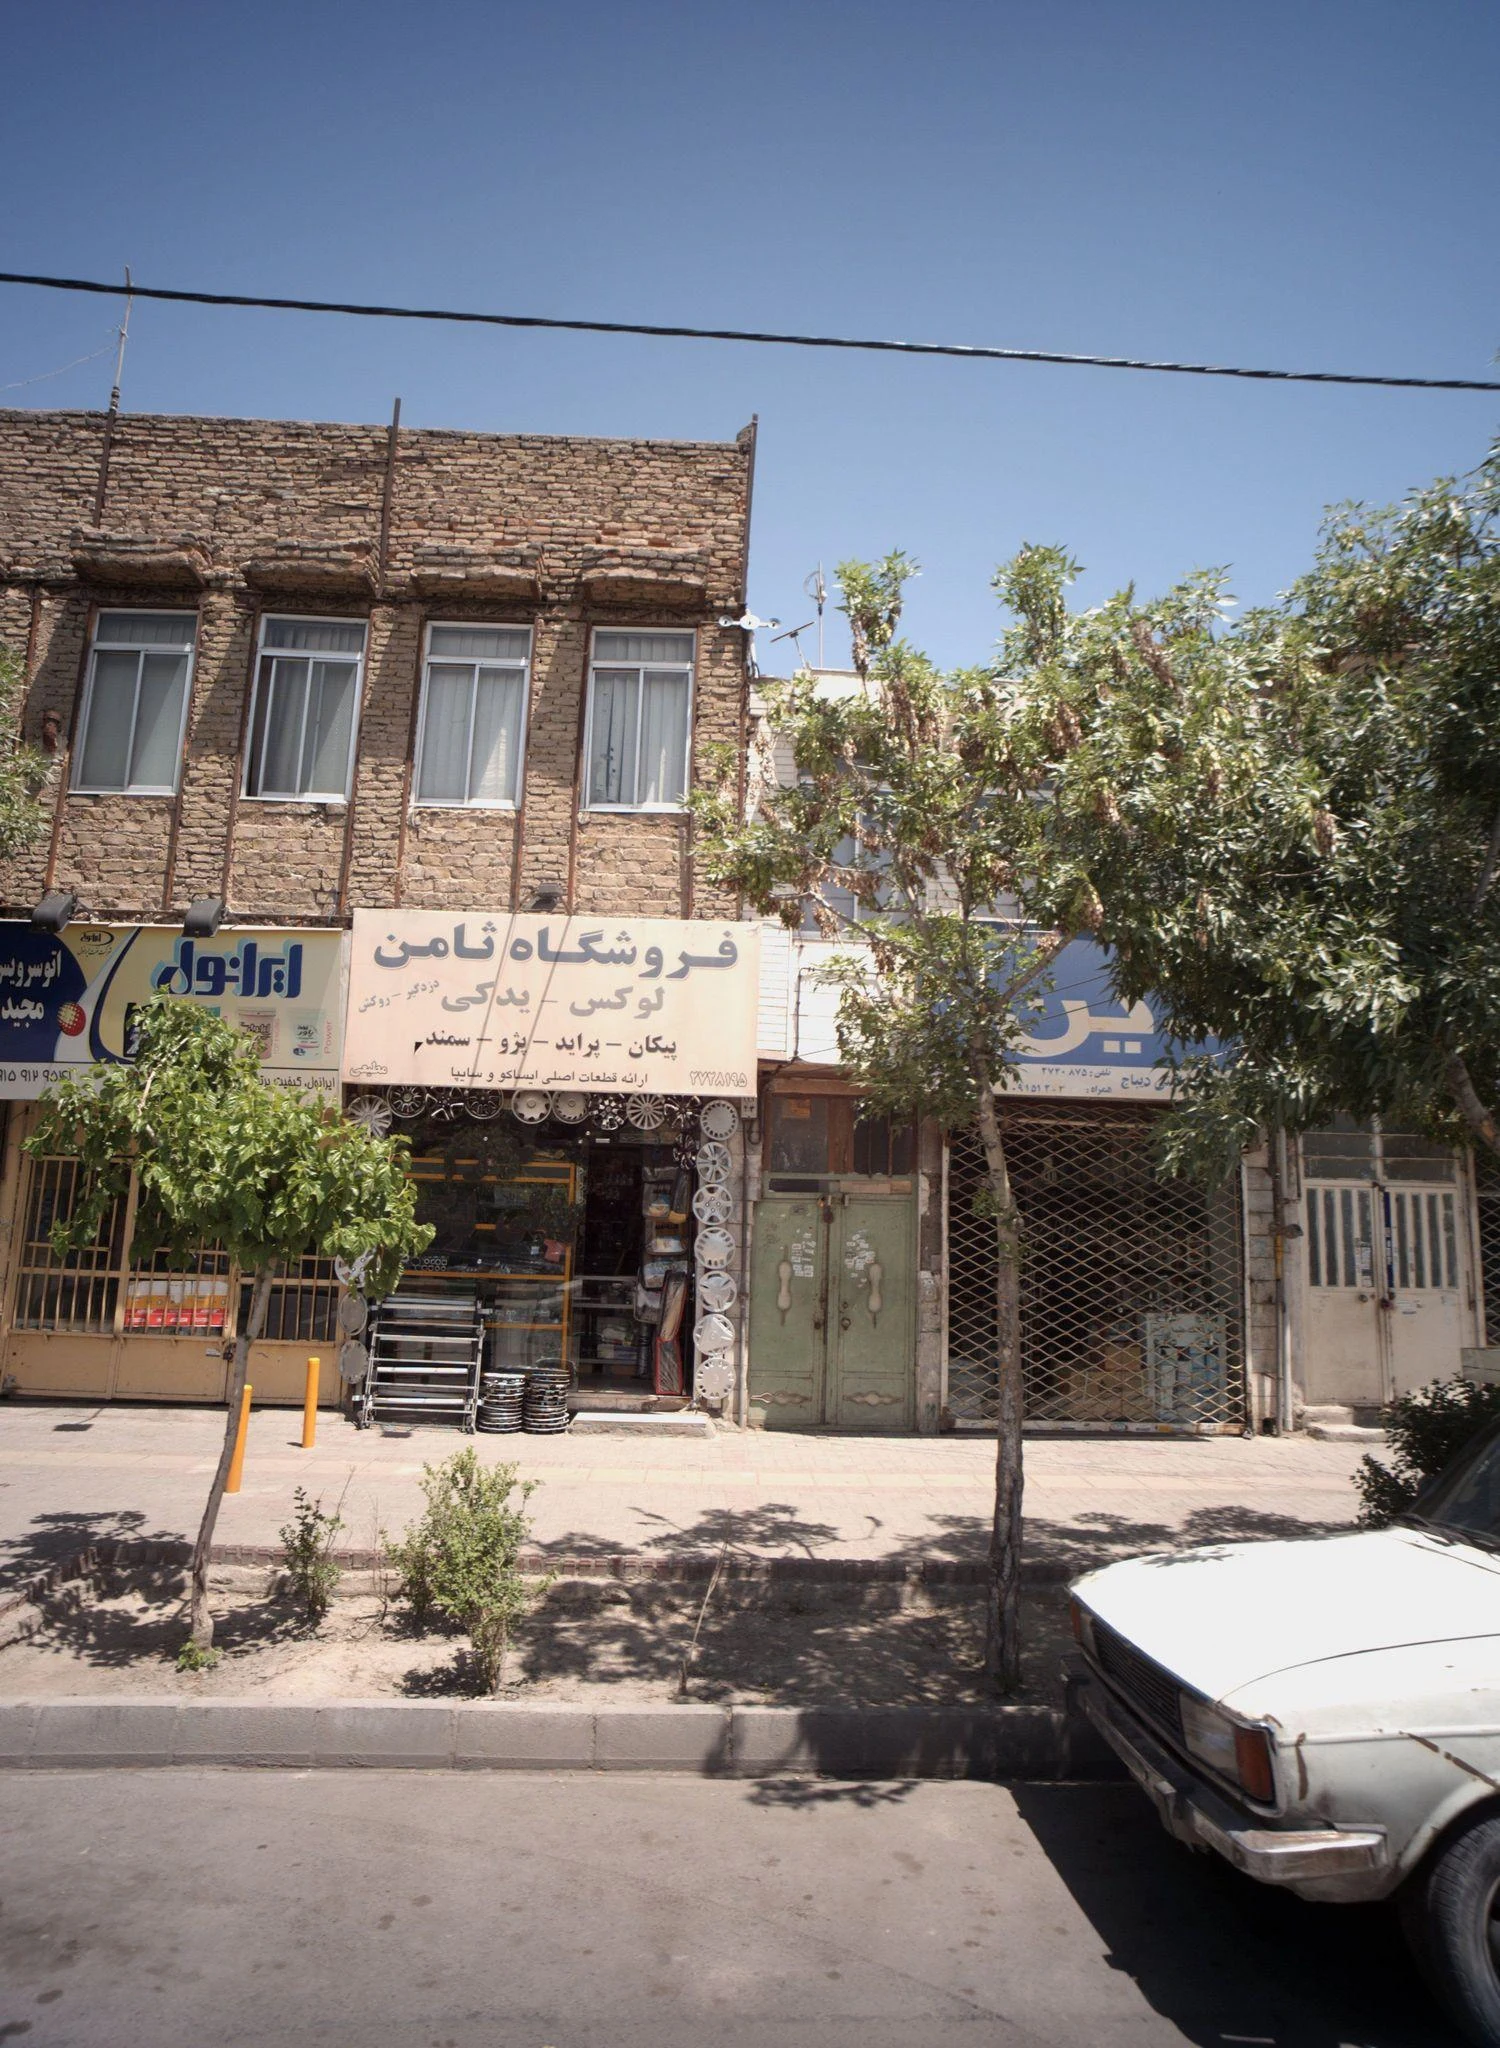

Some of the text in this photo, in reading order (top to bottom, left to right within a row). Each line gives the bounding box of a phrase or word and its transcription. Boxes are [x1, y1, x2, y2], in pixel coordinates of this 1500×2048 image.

[373, 920, 739, 980] فروشگاه ثامن
[155, 938, 303, 998] ایرانول
[1, 997, 45, 1028] مجید
[358, 980, 440, 1013] دزدگیر روکش
[441, 980, 666, 1019] لوکس یدکی
[323, 1020, 334, 1055] Power
[425, 1029, 678, 1061] پیکان پراید پژو سمند
[450, 1066, 648, 1088] ارائه قطعات اصلی ایساکو و سایپا
